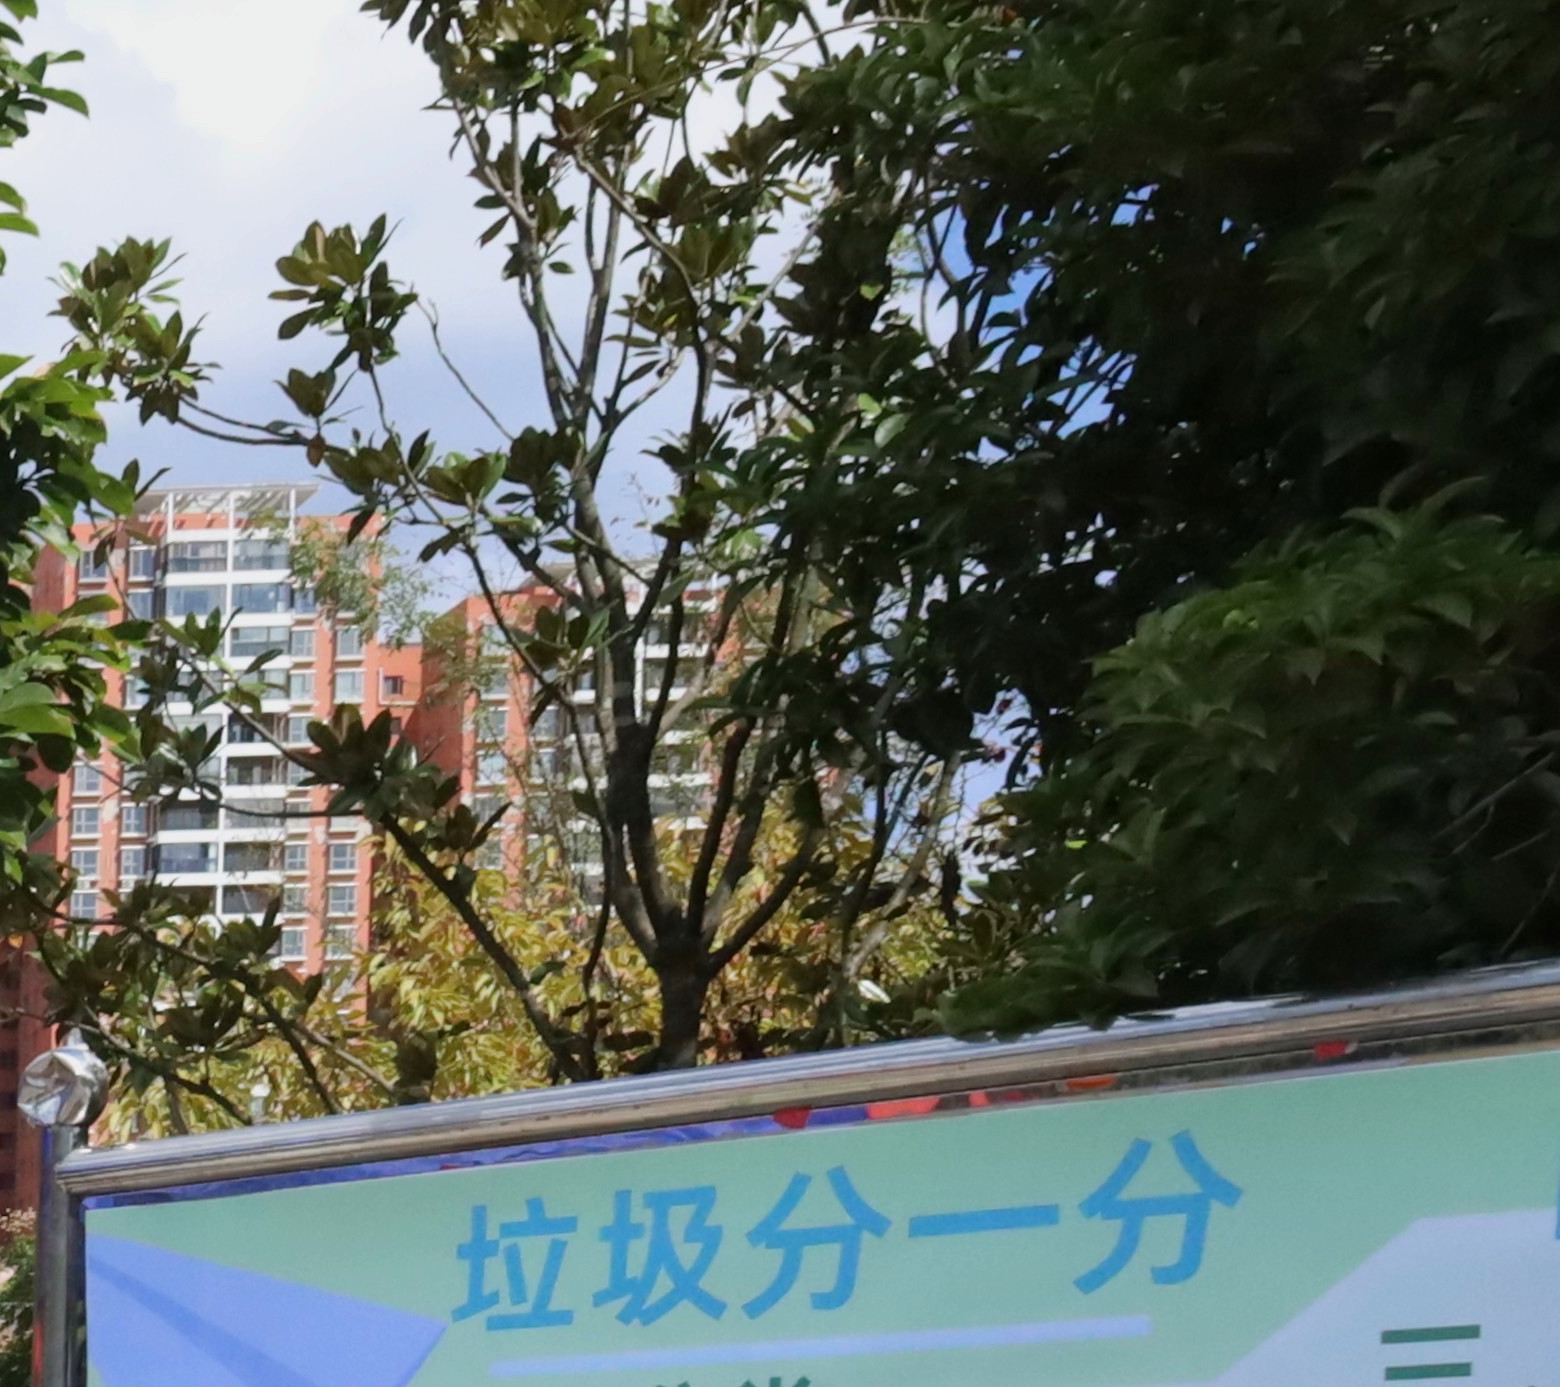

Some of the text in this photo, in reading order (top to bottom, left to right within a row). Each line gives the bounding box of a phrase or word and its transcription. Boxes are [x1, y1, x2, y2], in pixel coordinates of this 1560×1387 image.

[450, 1129, 1244, 1332] 垃圾分一分
